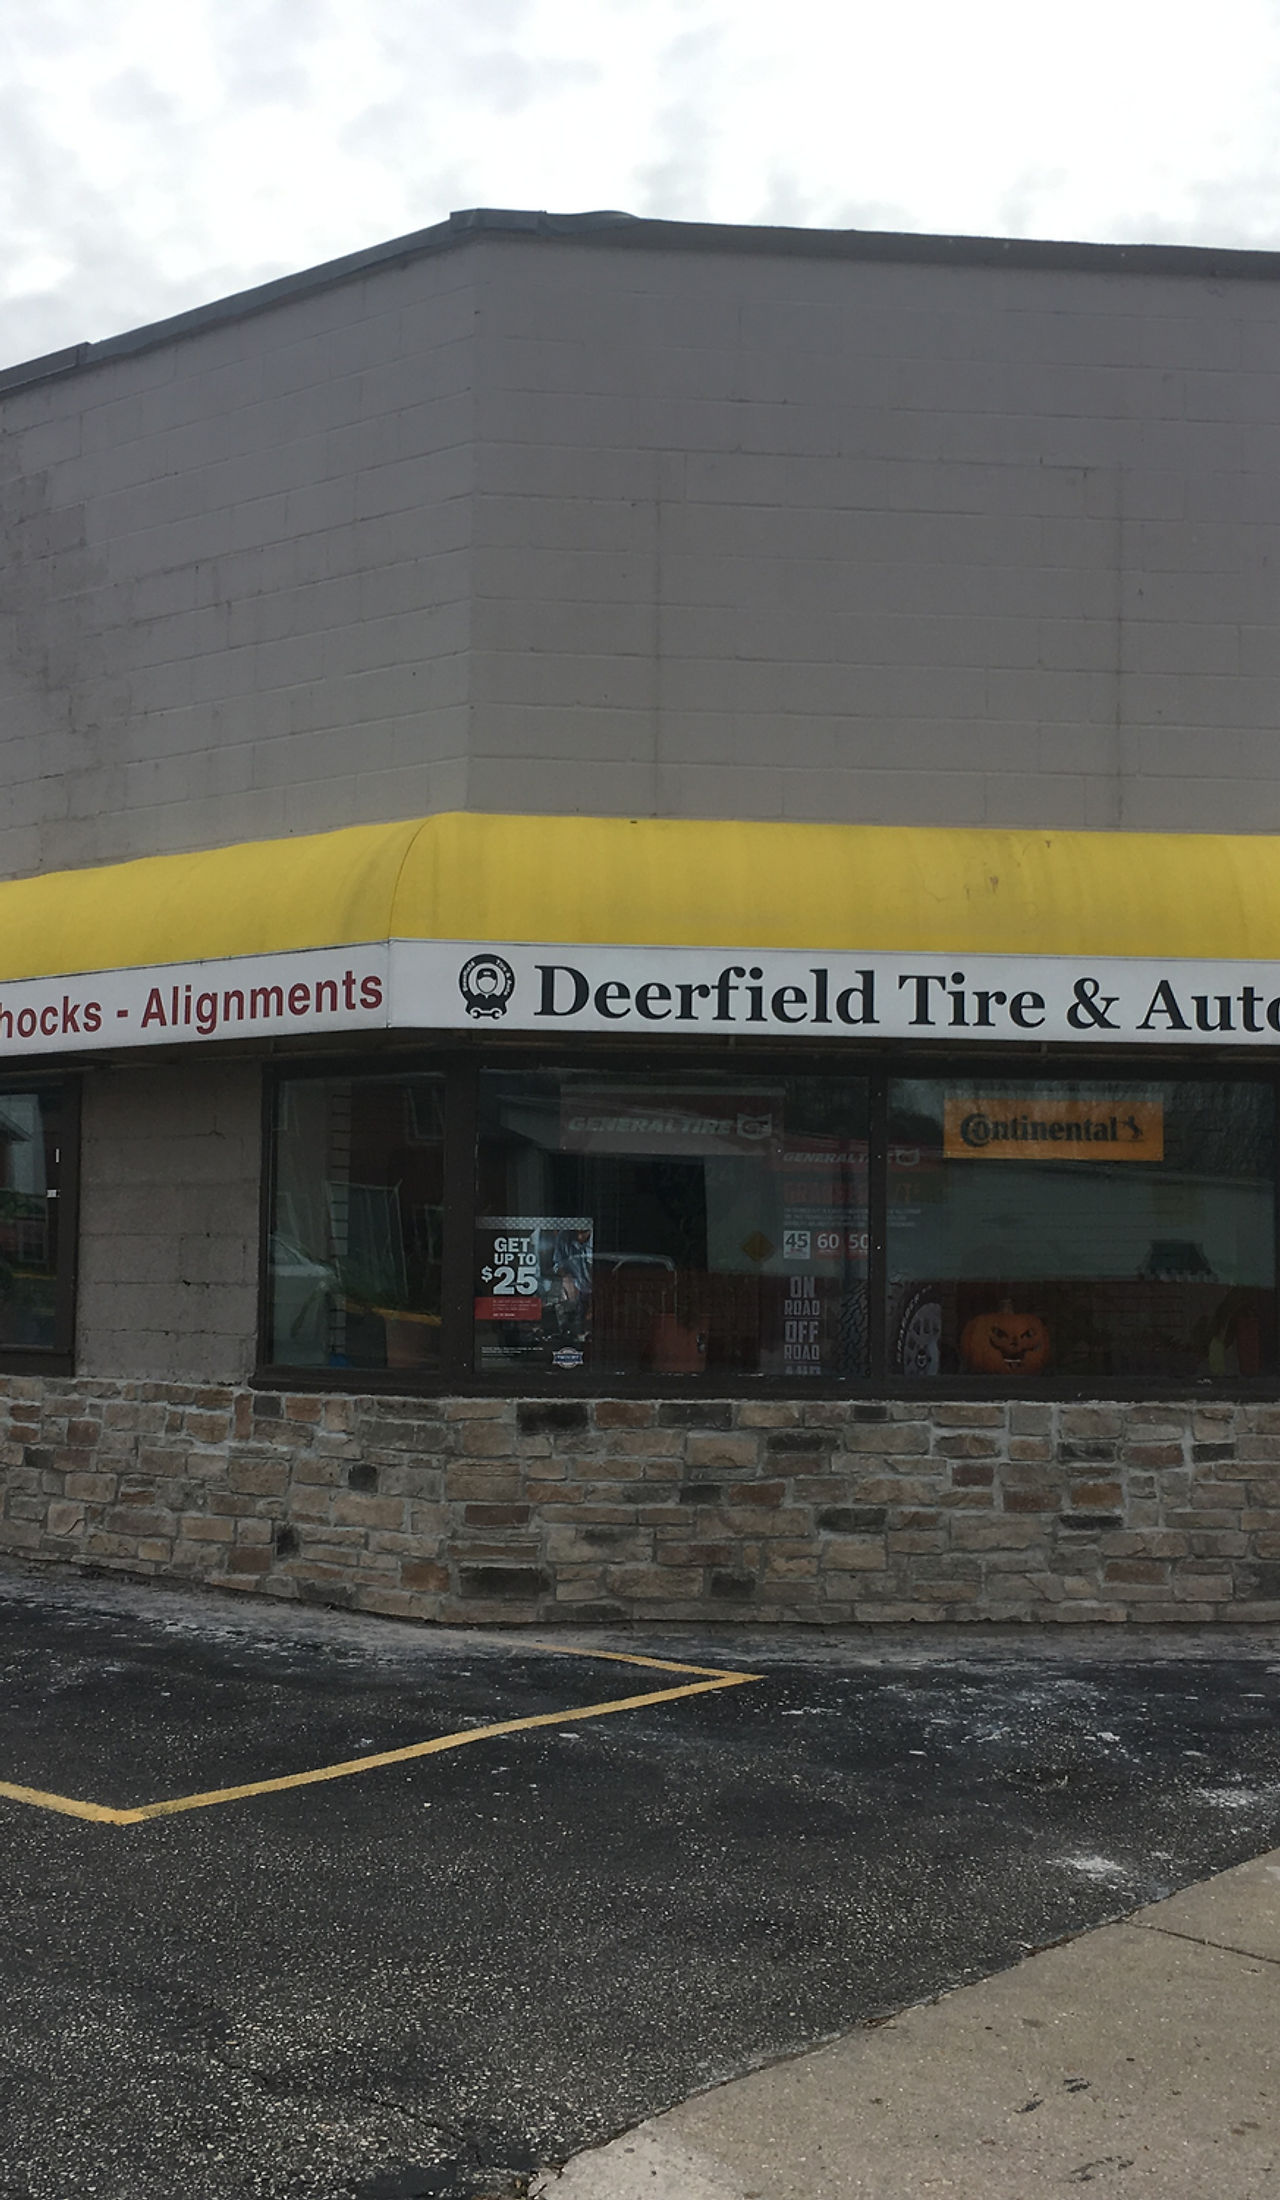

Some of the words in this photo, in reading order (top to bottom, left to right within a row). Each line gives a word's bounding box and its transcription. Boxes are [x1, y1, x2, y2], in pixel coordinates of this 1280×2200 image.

[141, 970, 383, 1035] Alignments
[534, 965, 880, 1025] Deerfield
[898, 971, 1046, 1029] Tire
[1066, 977, 1121, 1030] &
[568, 1115, 678, 1134] GENERAL
[679, 1117, 735, 1135] TIRE
[960, 1112, 1118, 1148] Continental
[494, 1237, 530, 1252] GET
[785, 1233, 808, 1249] 45
[817, 1233, 840, 1249] 60
[494, 1253, 515, 1265] UP
[517, 1253, 537, 1265] TO
[481, 1266, 538, 1295] $25
[790, 1276, 815, 1298] ON
[784, 1300, 821, 1316] ROAD
[784, 1320, 819, 1343] OFF
[784, 1344, 820, 1360] ROAD
